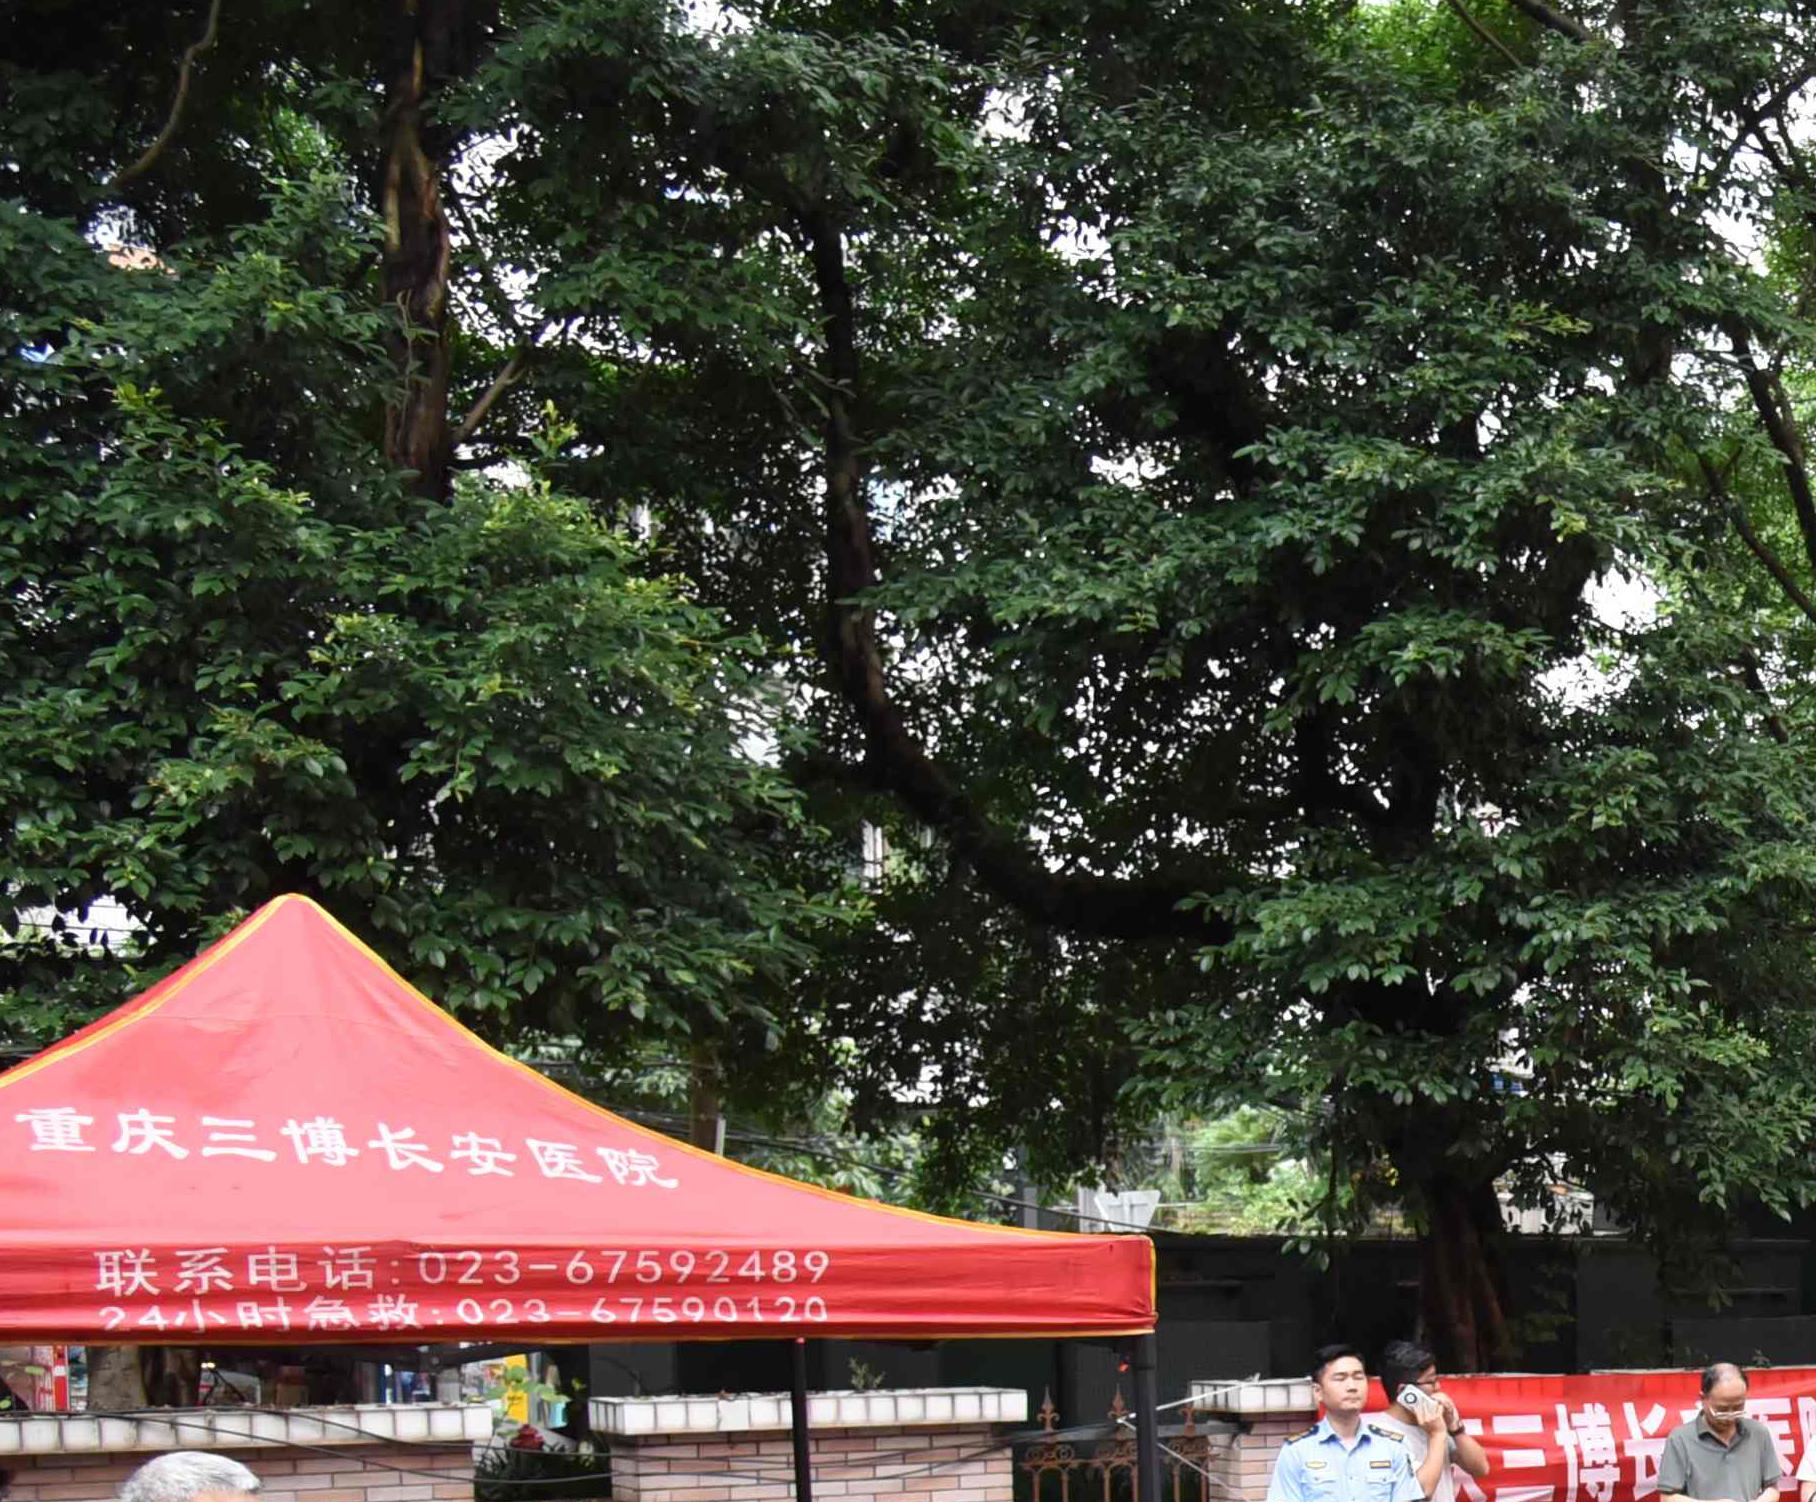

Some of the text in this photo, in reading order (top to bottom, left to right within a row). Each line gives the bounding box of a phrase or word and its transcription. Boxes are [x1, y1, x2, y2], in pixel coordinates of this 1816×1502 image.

[15, 1107, 679, 1189] 重庆三博长安医院
